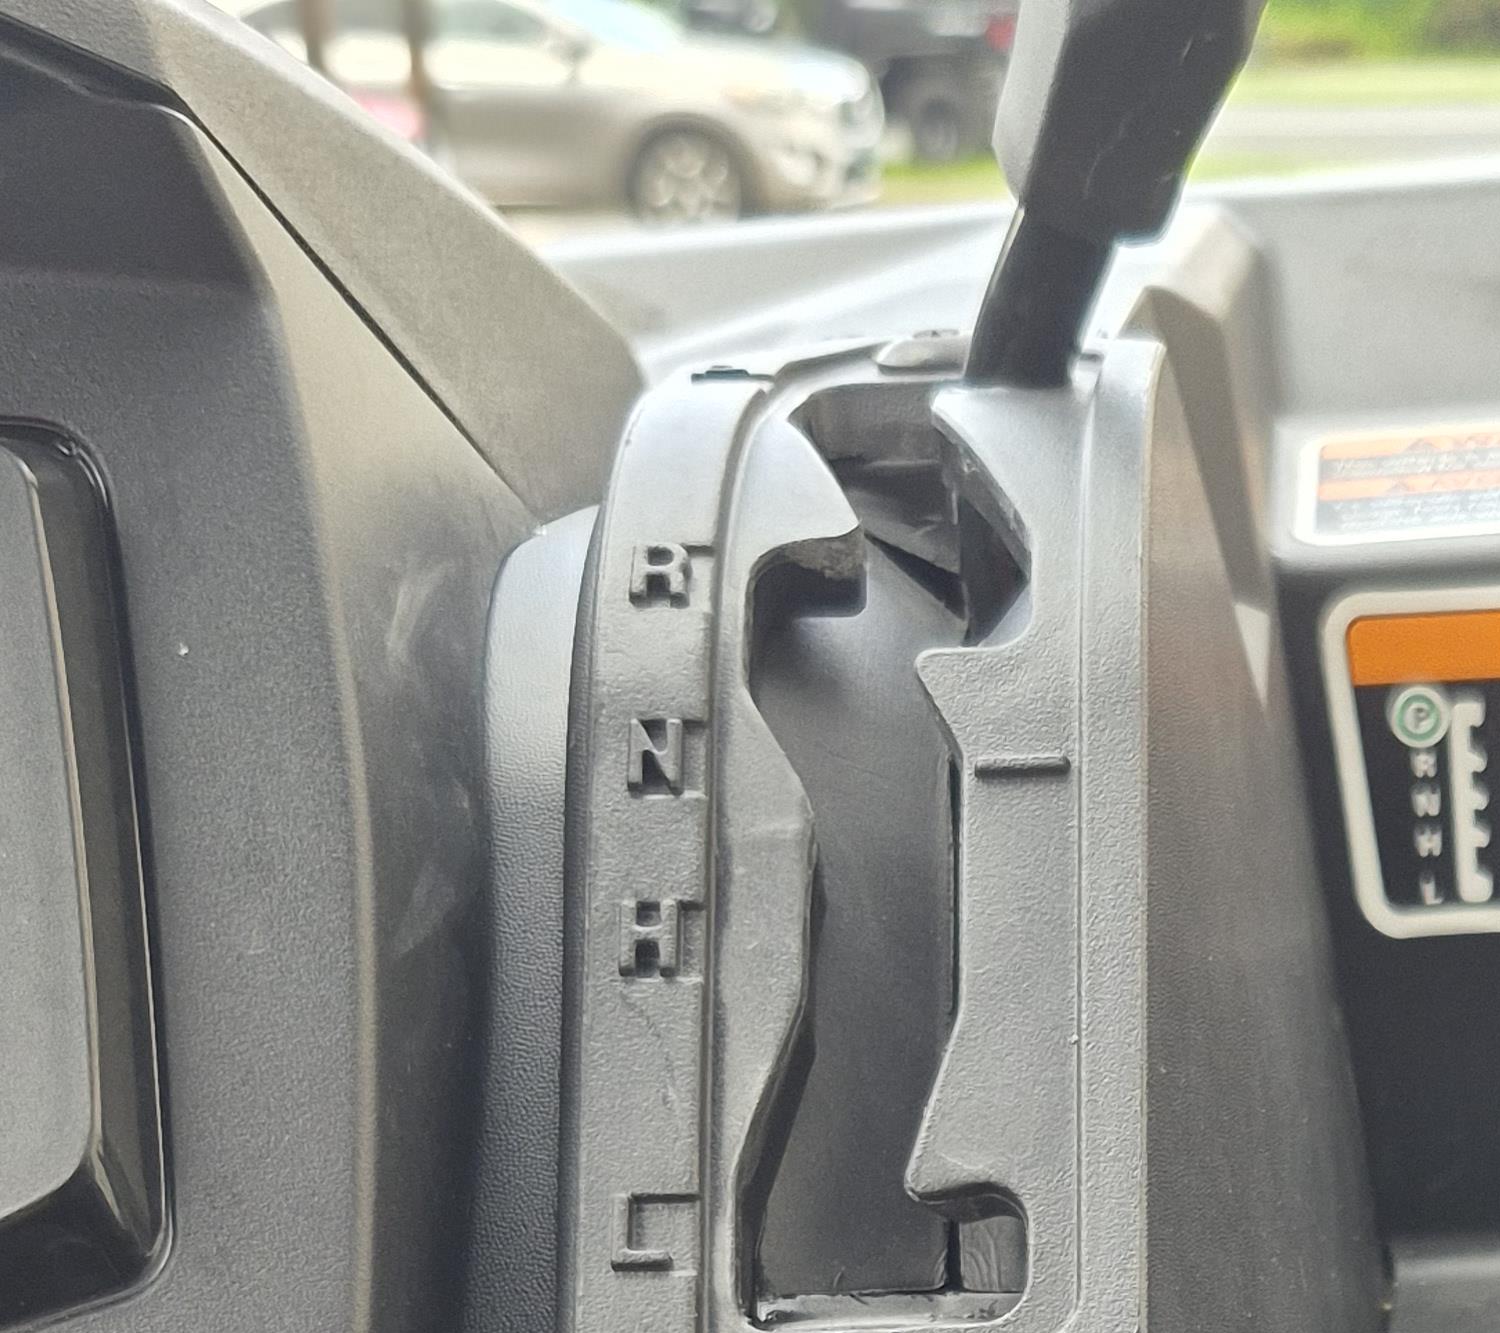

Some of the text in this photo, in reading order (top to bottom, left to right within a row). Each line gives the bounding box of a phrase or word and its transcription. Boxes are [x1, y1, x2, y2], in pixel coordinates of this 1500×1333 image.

[630, 541, 691, 606] R
[627, 718, 684, 795] N
[620, 899, 678, 977] H
[611, 1197, 673, 1272] L
